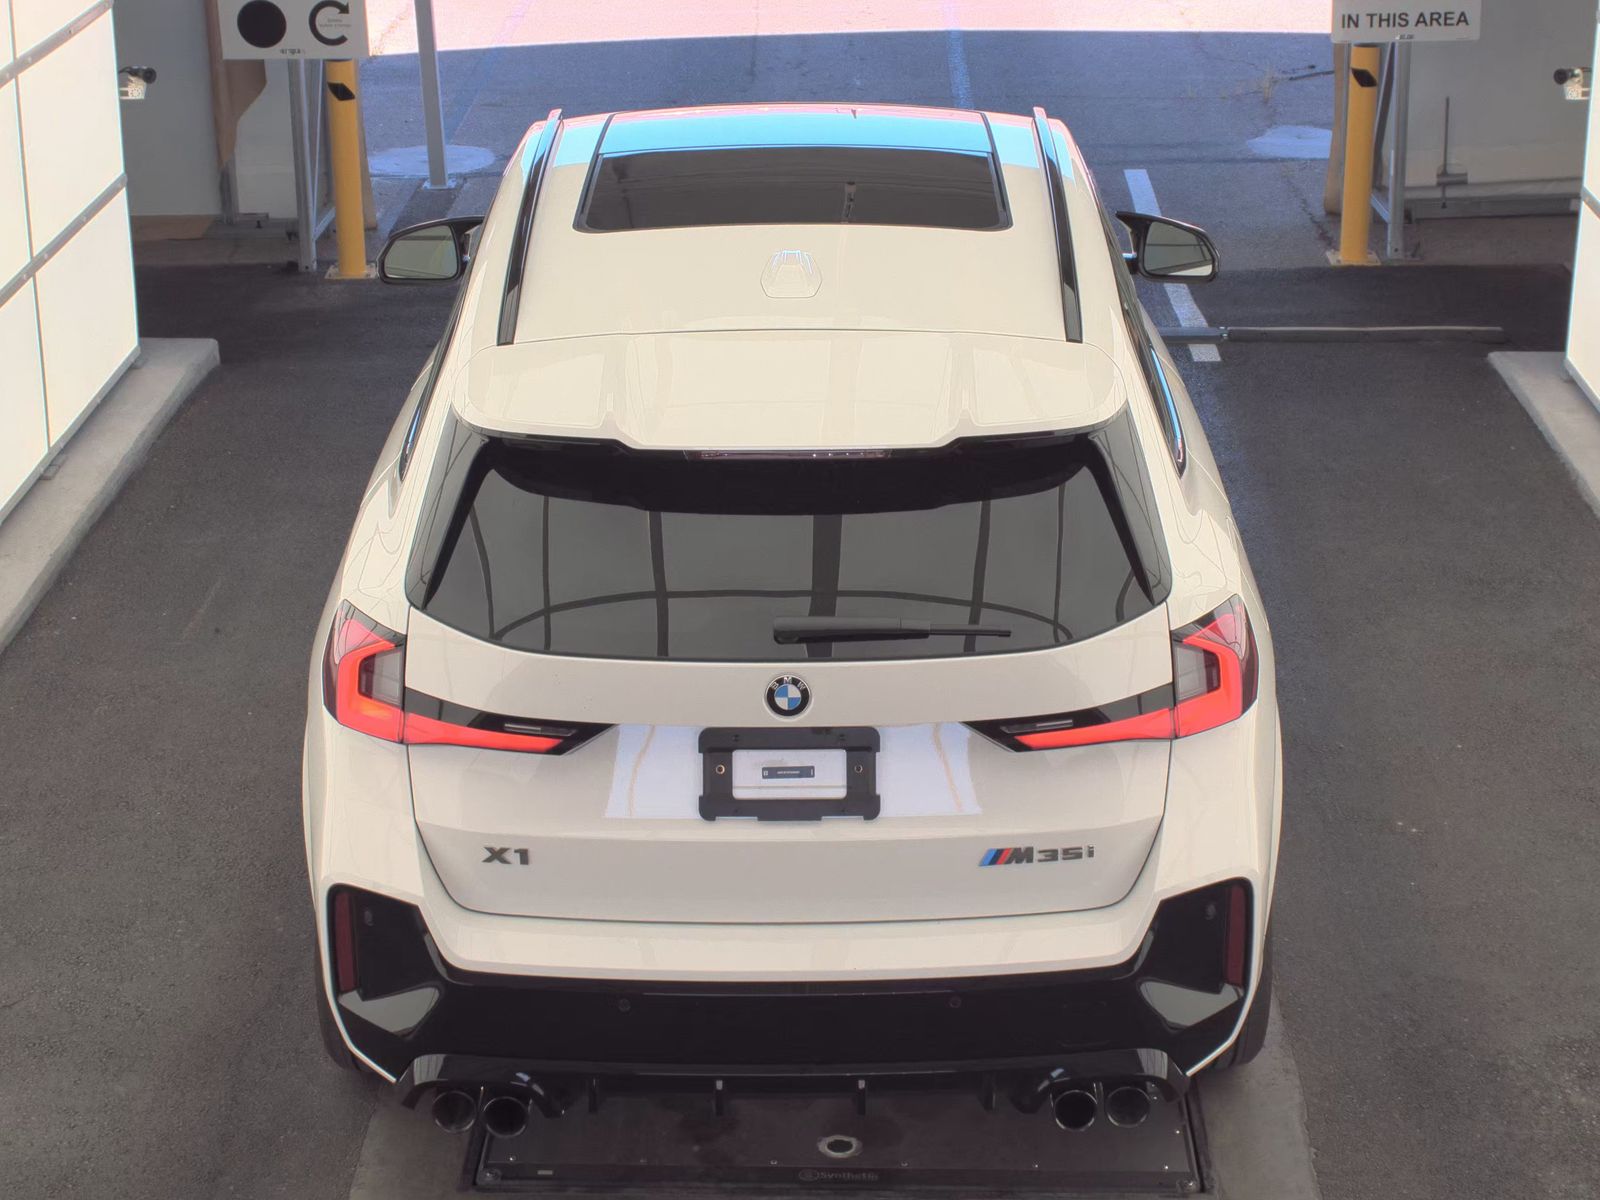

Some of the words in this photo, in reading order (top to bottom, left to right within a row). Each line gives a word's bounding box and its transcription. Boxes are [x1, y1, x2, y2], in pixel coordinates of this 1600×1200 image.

[1341, 13, 1360, 28] IN
[1366, 12, 1410, 28] THIS
[1415, 11, 1470, 27] AREA
[481, 846, 530, 866] X1
[1006, 844, 1095, 864] M35i
